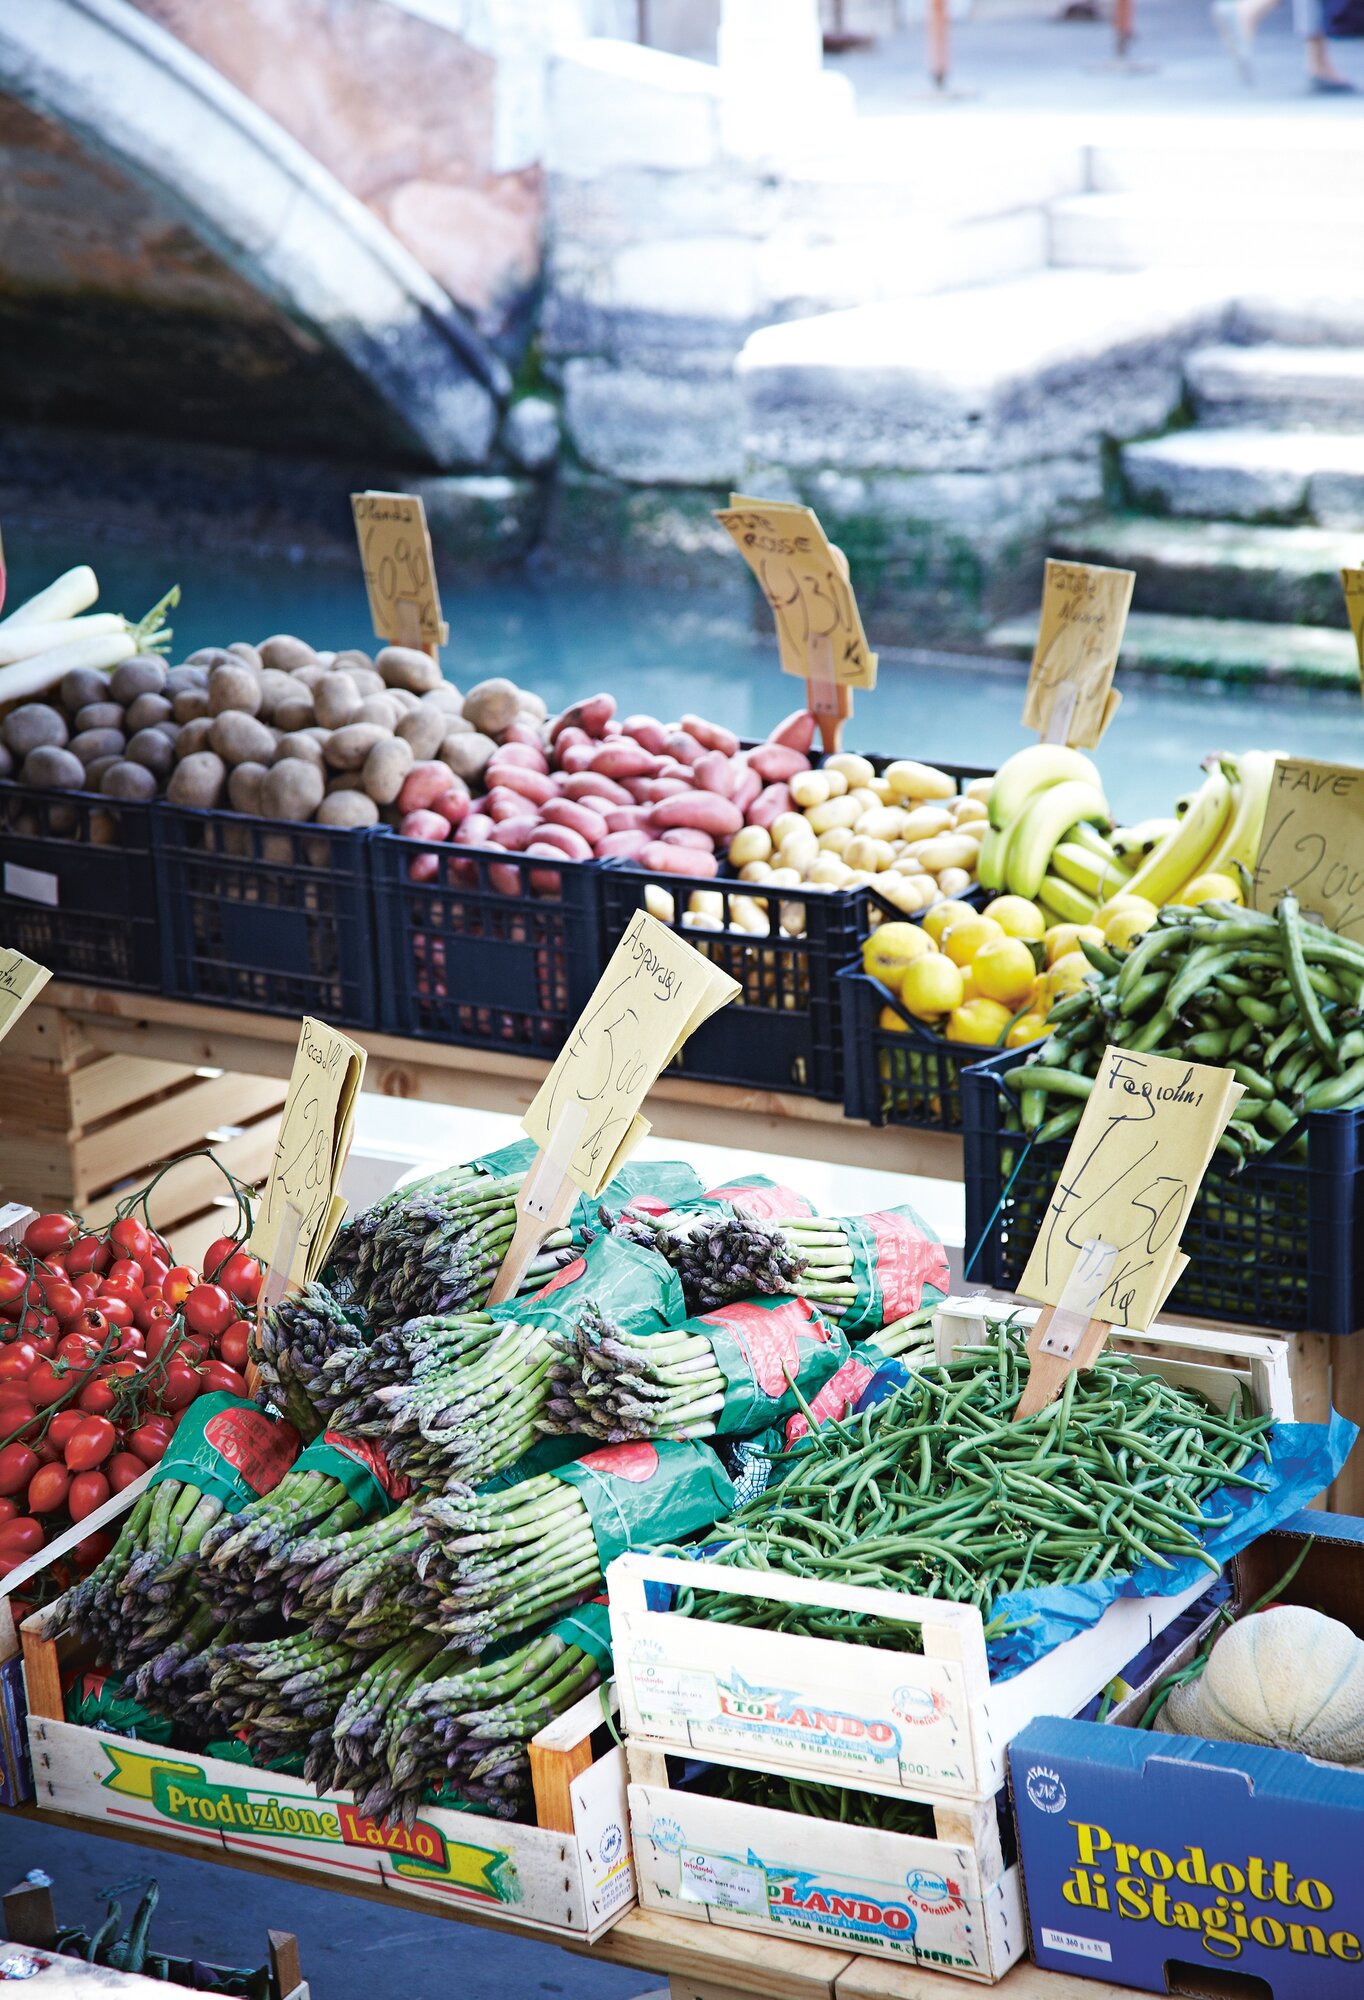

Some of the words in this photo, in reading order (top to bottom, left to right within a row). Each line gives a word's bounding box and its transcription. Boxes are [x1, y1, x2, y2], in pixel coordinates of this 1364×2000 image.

[1277, 764, 1358, 796] FAVE
[623, 917, 683, 1001] Asparagi
[1027, 1765, 1060, 1784] ITALIA
[167, 1785, 343, 1838] Produzione
[346, 1814, 434, 1859] Lazio
[1067, 1820, 1334, 1912] Prodotto
[1062, 1867, 1111, 1912] di
[1115, 1877, 1363, 1961] Stagione
